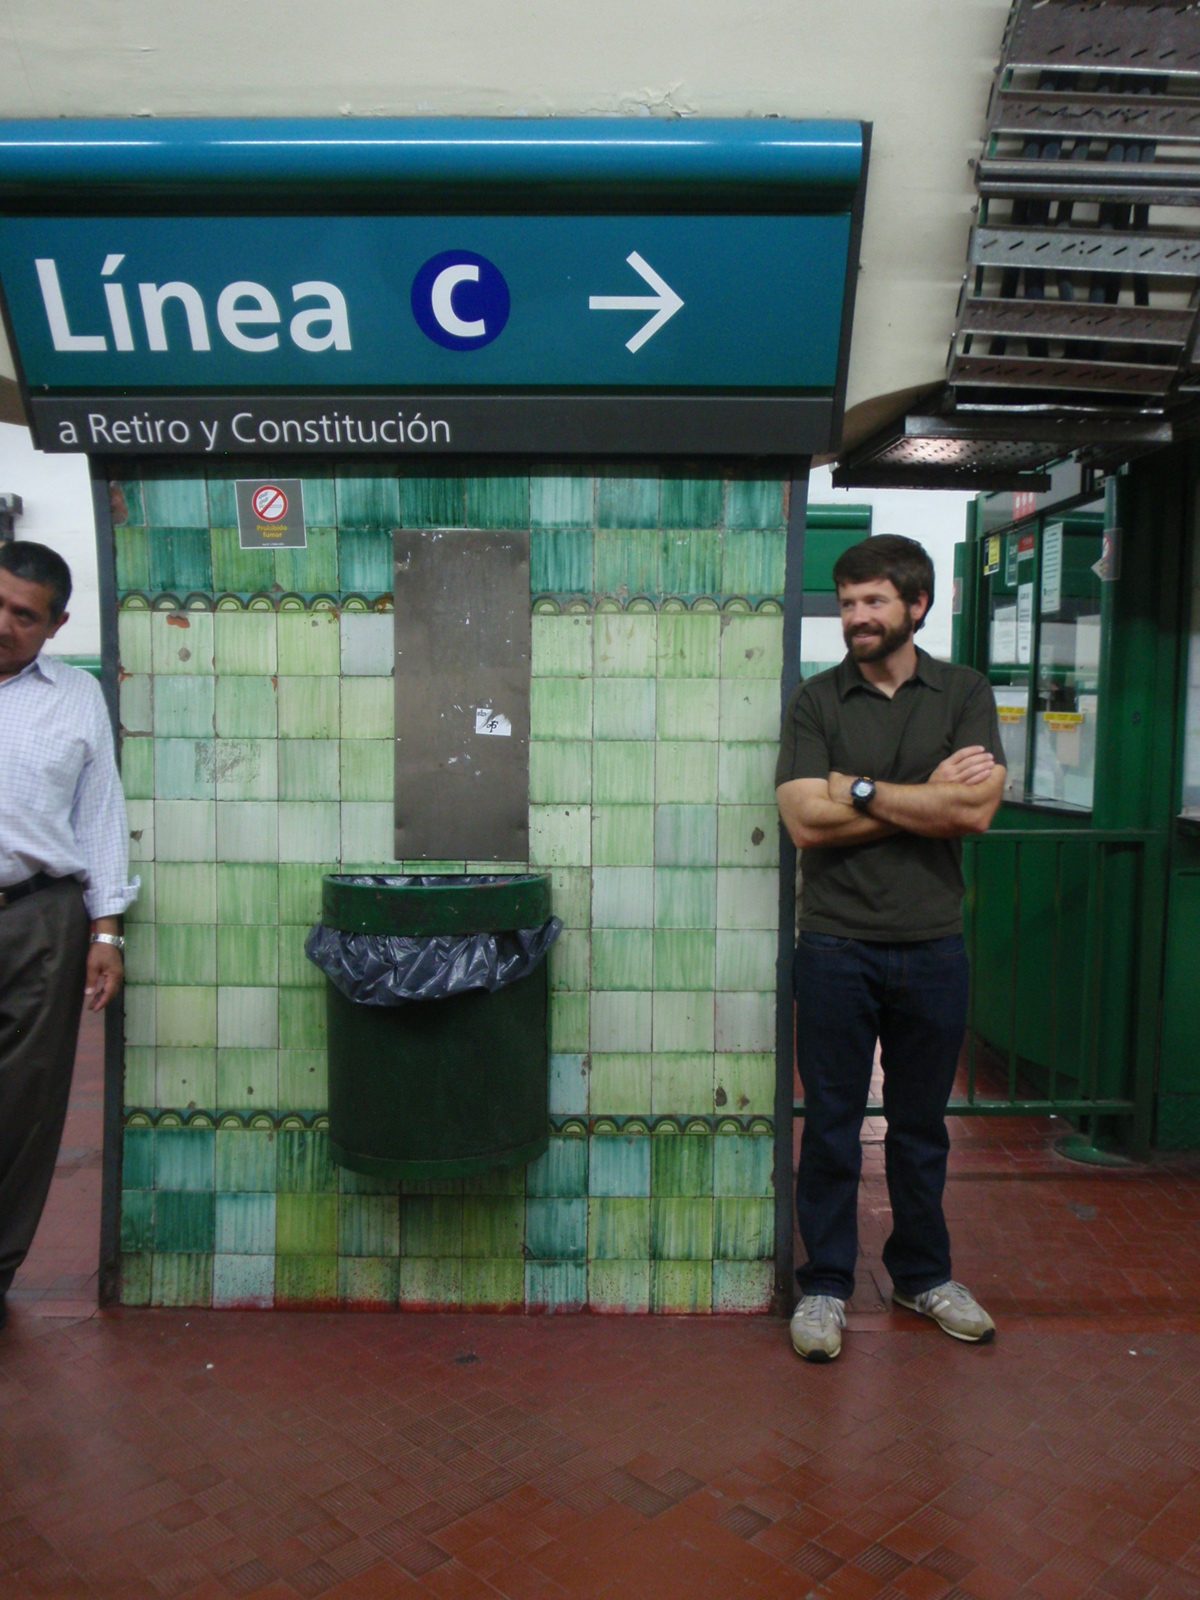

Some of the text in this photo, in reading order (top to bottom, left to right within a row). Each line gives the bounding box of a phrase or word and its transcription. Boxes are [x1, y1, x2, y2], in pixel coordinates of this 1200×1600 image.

[35, 254, 486, 352] Línea C
[58, 412, 451, 451] a Retiro y Constitución
